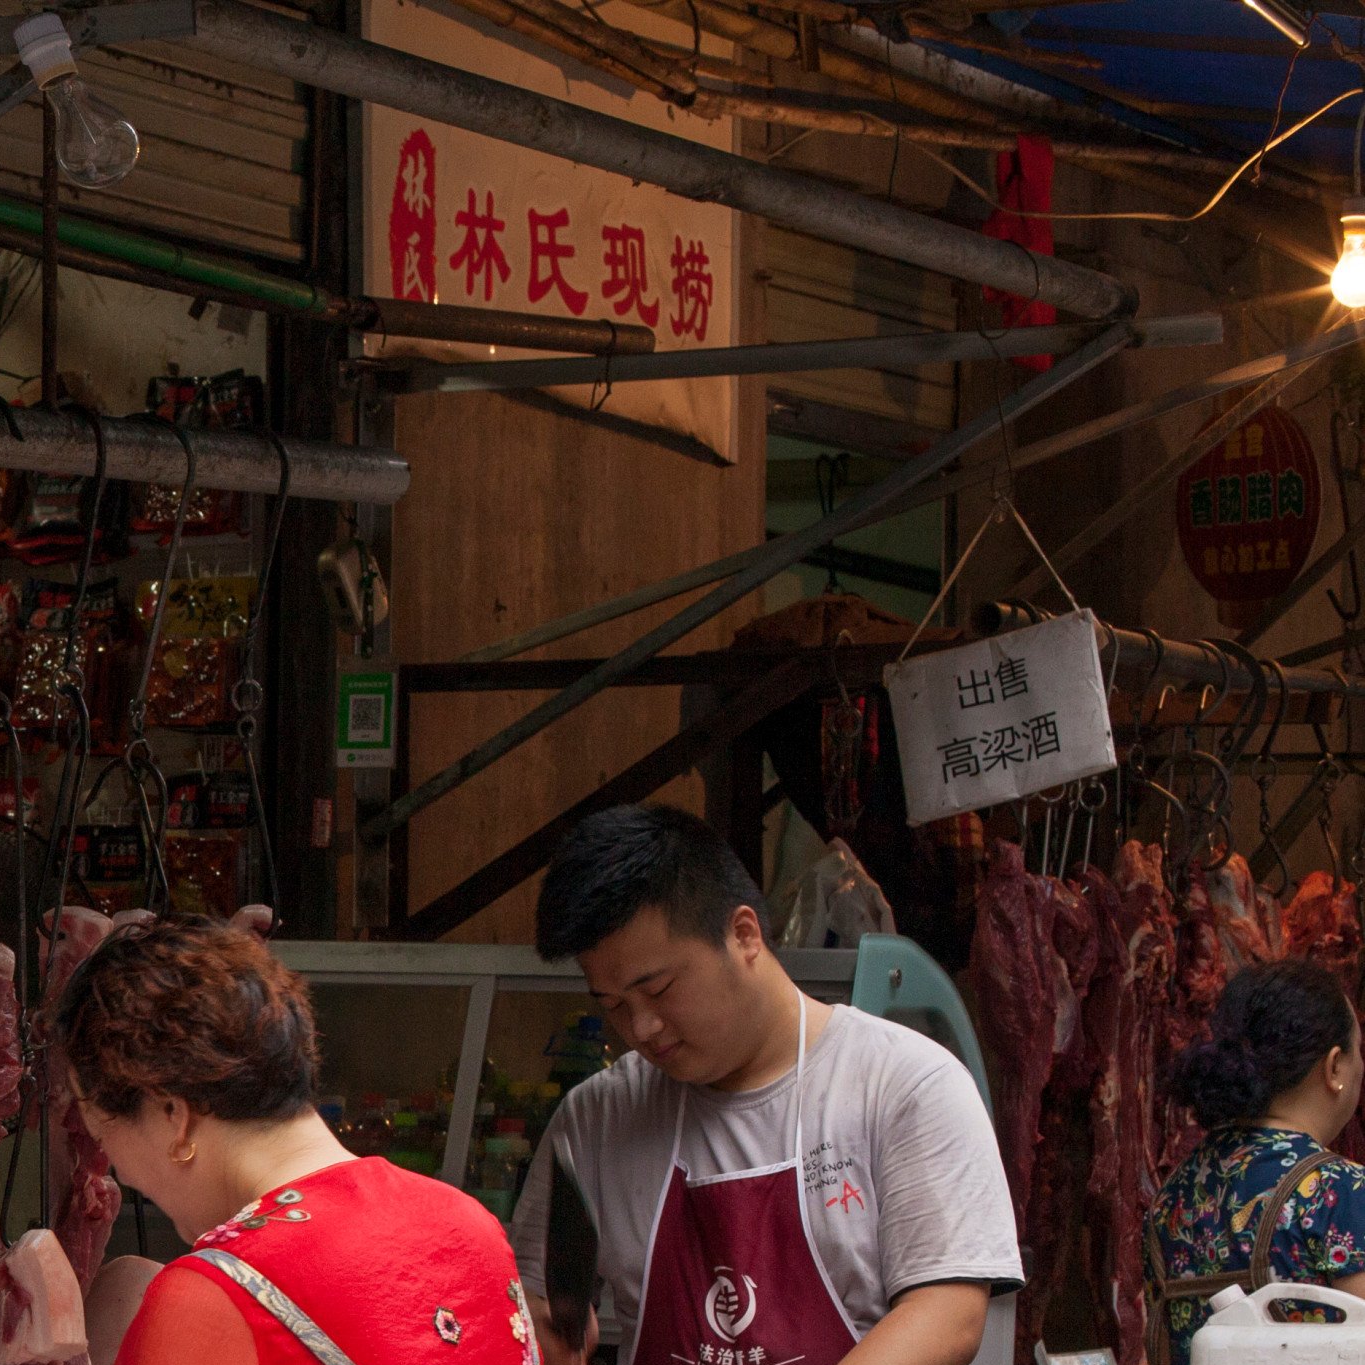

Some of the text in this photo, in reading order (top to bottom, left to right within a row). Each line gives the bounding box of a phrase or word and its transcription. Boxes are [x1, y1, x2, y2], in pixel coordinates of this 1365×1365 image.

[449, 188, 713, 341] 林氏现捞
[956, 657, 1029, 710] 出售
[809, 1142, 833, 1158] HERE
[821, 1157, 852, 1174] KNOW
